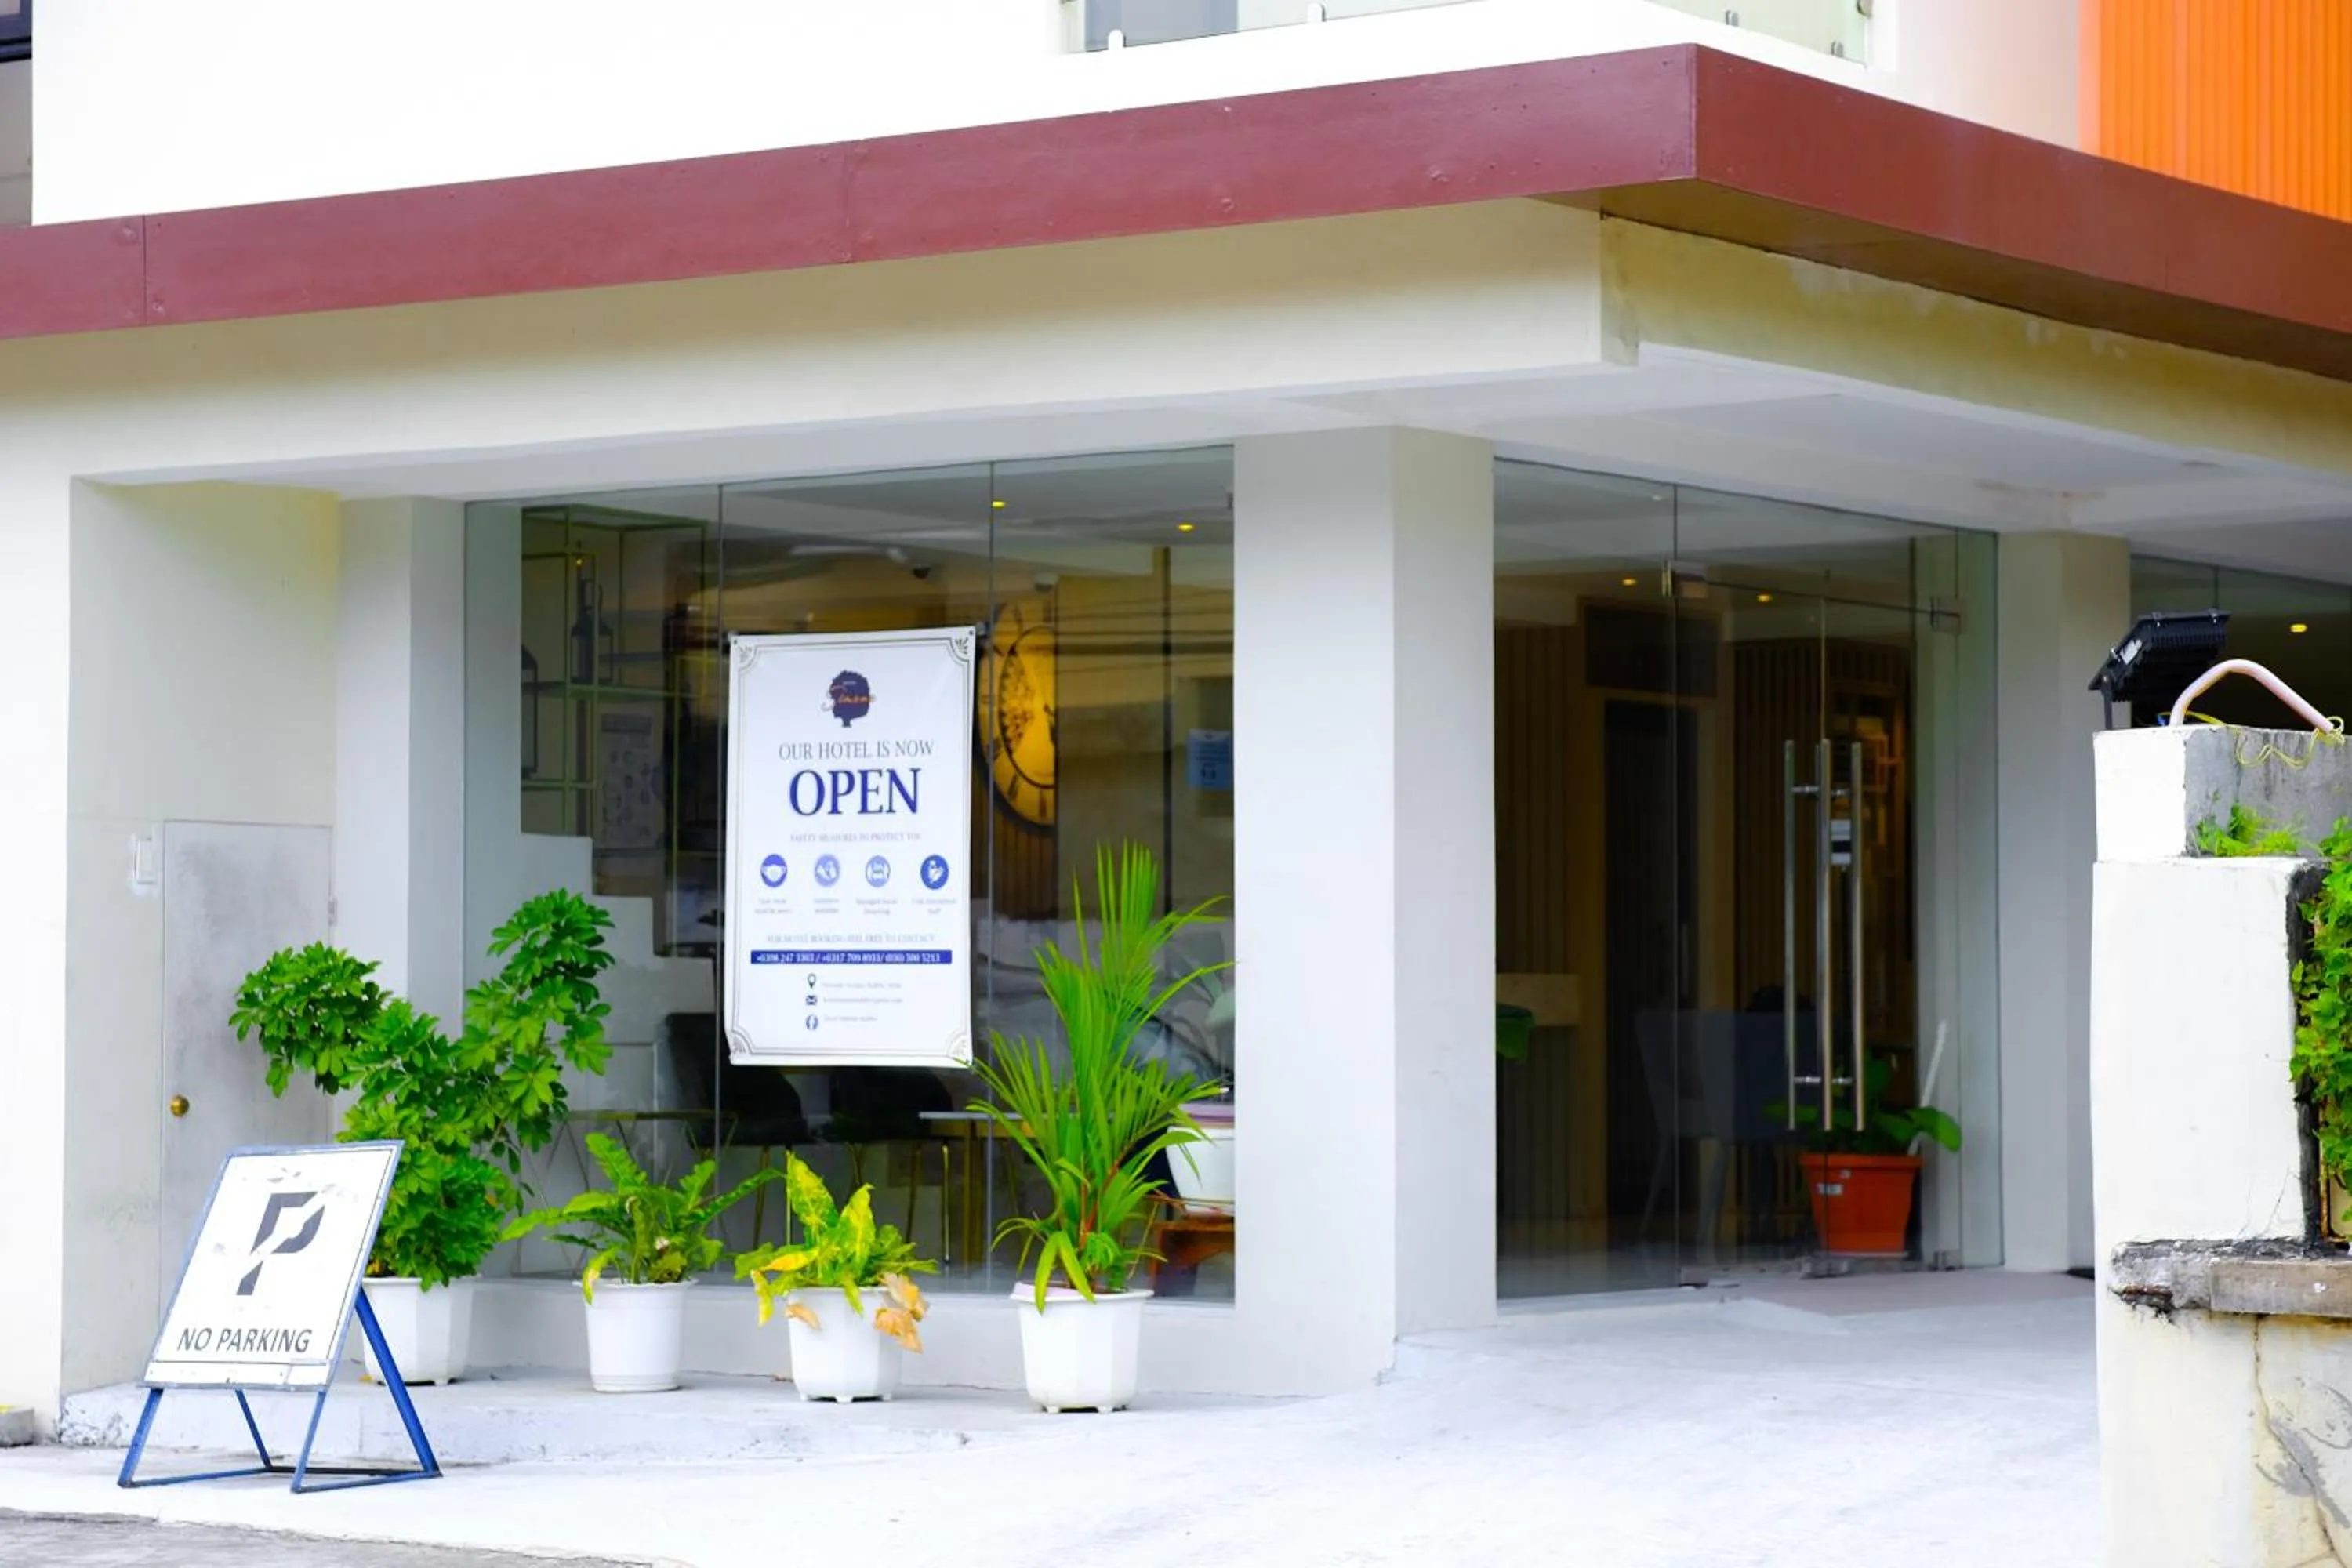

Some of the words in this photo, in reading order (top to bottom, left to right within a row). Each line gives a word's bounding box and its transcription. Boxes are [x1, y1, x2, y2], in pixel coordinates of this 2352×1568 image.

[779, 742, 813, 760] OUR
[818, 741, 873, 760] HOTEL
[877, 741, 891, 759] IS
[895, 739, 935, 759] NOW
[789, 768, 921, 816] OPEN
[177, 1328, 212, 1351] NO
[216, 1327, 313, 1353] PARKING
